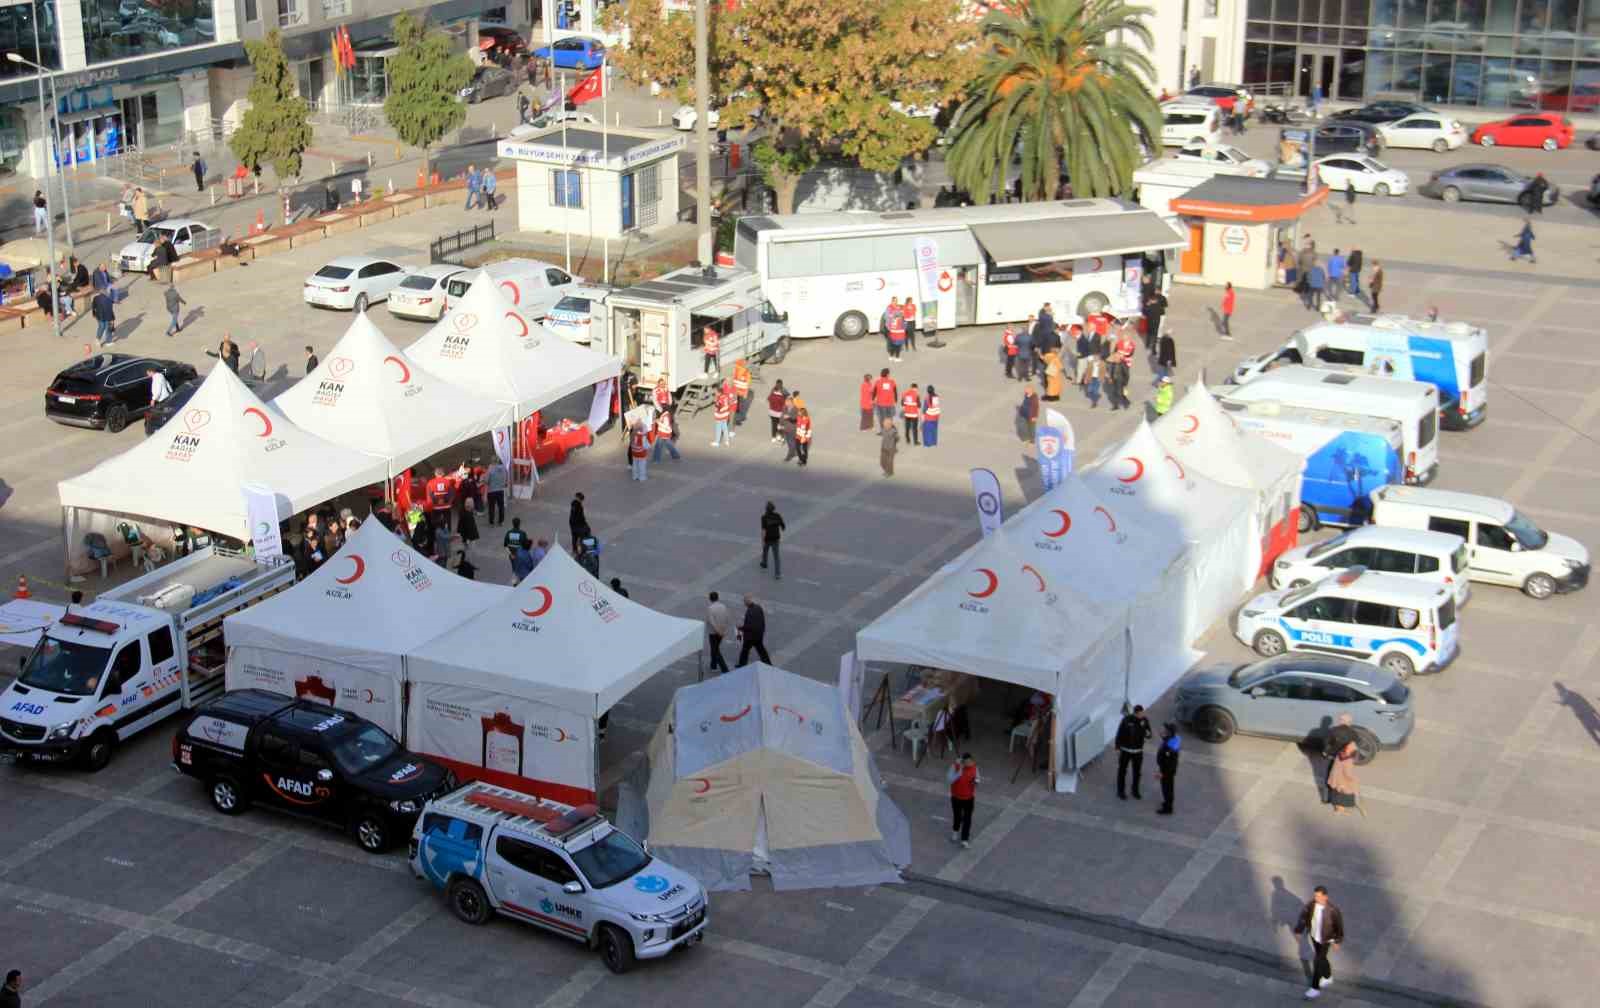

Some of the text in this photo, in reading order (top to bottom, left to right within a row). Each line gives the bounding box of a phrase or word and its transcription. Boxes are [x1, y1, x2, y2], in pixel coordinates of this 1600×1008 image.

[445, 335, 470, 346] KAN
[320, 381, 344, 393] KAN
[174, 434, 200, 447] KAN
[1300, 630, 1333, 645] POLİS
[10, 701, 44, 715] AFAD
[312, 713, 345, 732] AFAD
[277, 776, 313, 797] AFAD
[657, 884, 684, 901] UMKE
[554, 902, 583, 920] UMKE
